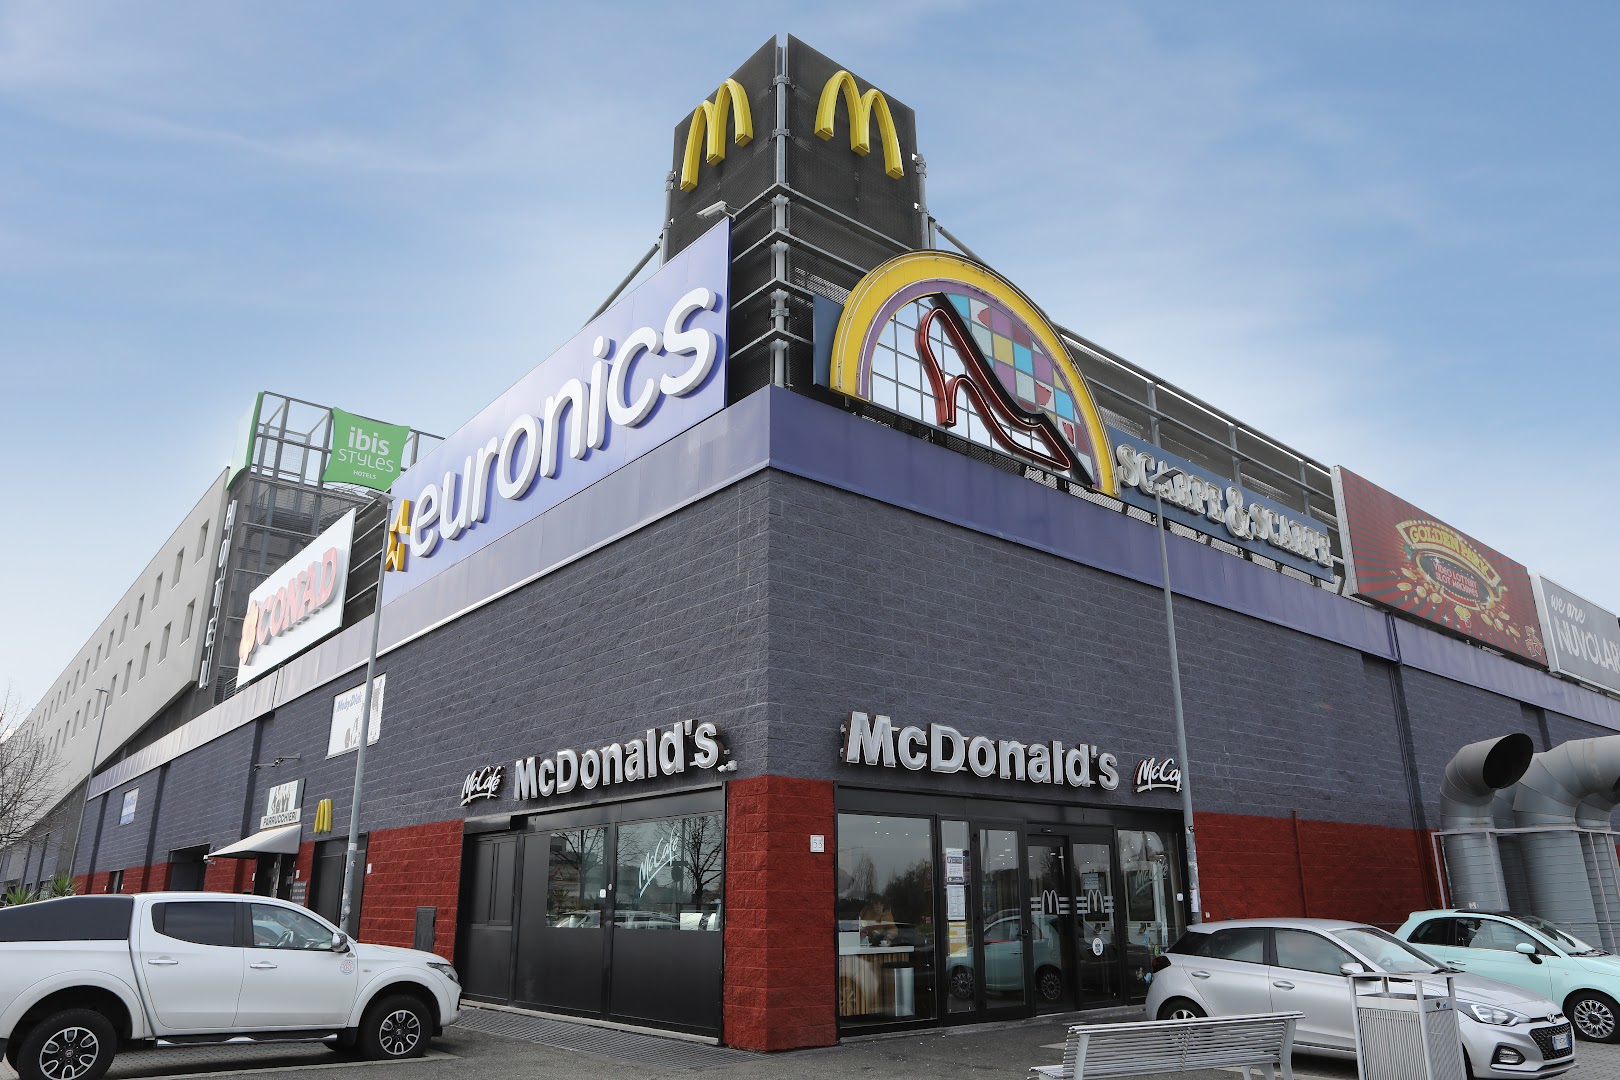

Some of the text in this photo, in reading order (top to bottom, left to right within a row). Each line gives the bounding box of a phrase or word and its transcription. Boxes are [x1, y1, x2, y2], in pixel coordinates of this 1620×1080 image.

[348, 426, 390, 456] ibis
[410, 287, 718, 558] euronics
[353, 469, 377, 480] HOTELS
[1116, 443, 1334, 568] SCARPE & SCARPE
[1409, 525, 1491, 577] GOLDEN PARK
[1433, 561, 1477, 589] VIDEO LOTTERY
[1435, 572, 1479, 598] SLOT MACHINES
[257, 546, 340, 646] CONAD
[1550, 593, 1586, 624] we are
[1553, 615, 1620, 674] NUVOLAR
[514, 718, 722, 802] McDonald's
[845, 710, 1120, 791] McDonald's
[460, 765, 504, 805] McCafé
[1136, 757, 1183, 793] McCa
[262, 810, 299, 827] PARRUCCHIERI
